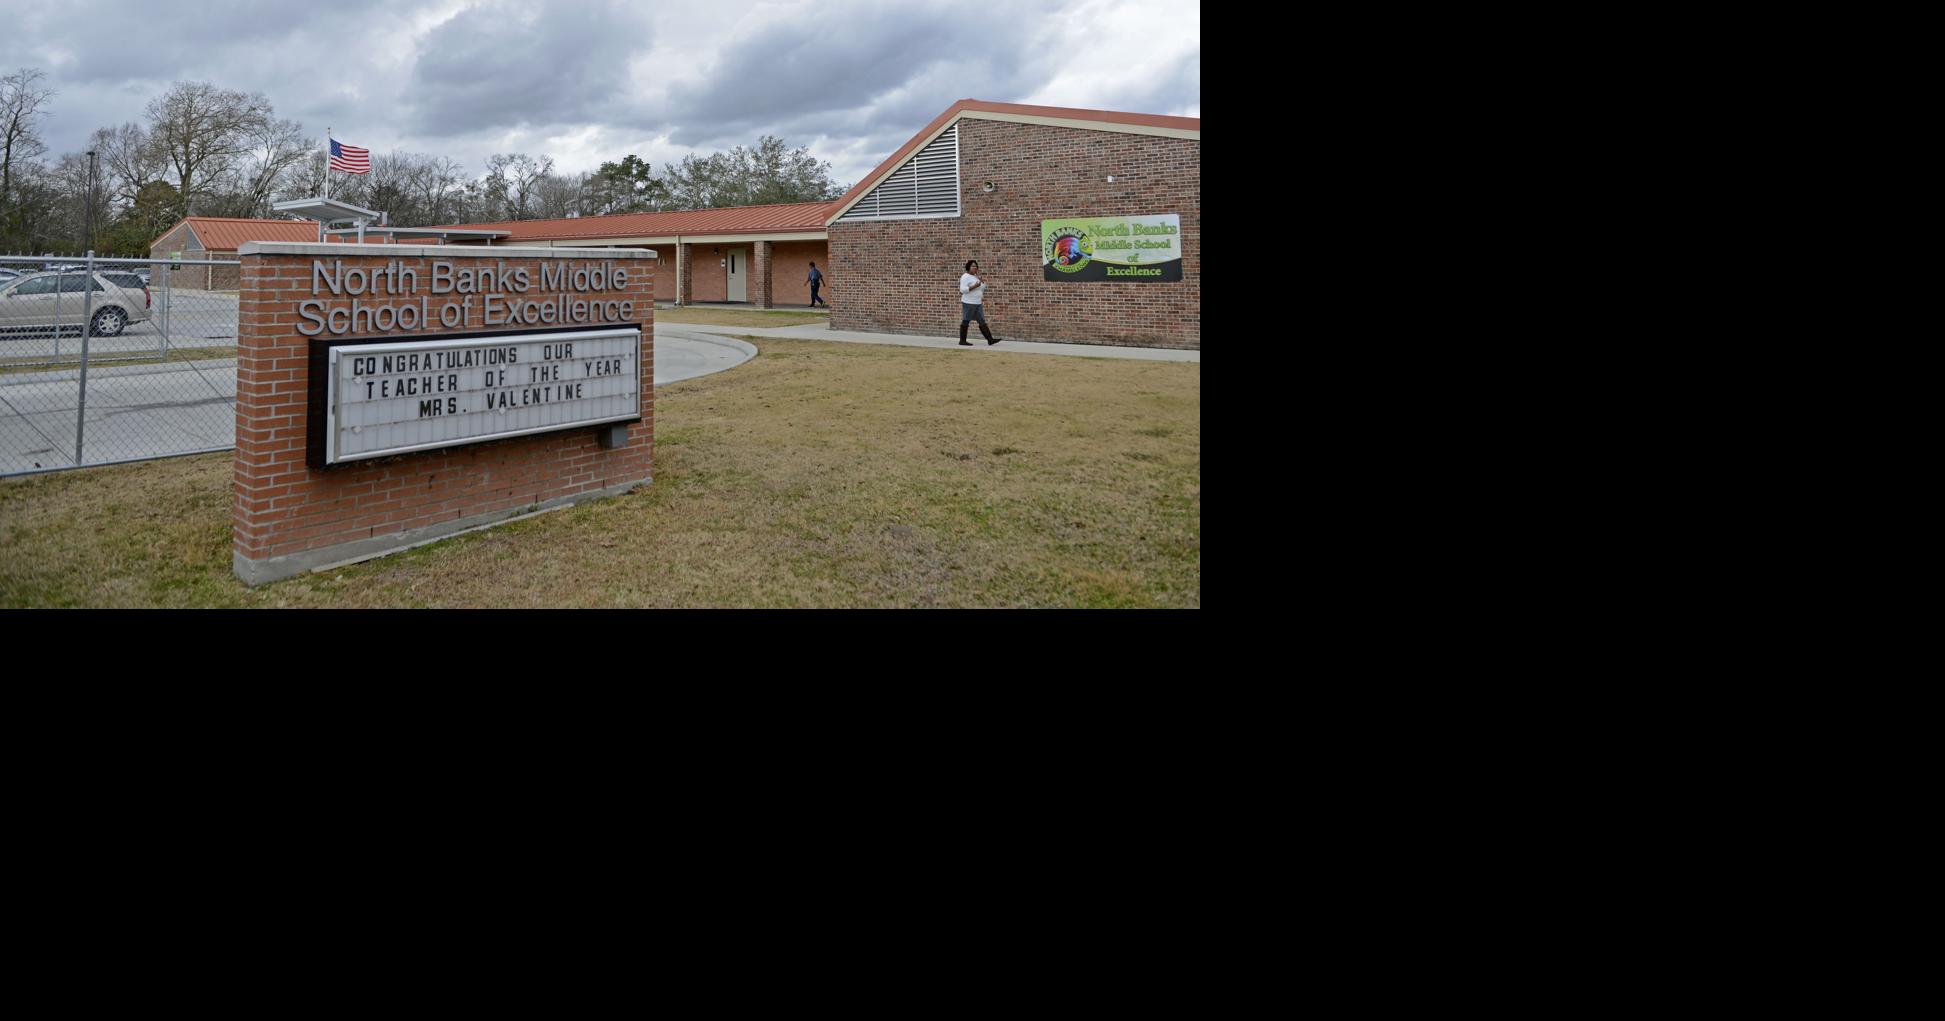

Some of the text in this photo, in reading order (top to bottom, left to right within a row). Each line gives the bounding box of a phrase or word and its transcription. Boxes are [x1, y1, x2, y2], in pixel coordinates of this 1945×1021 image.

[1087, 221, 1177, 237] North Banks
[1095, 238, 1171, 250] Middle School
[1106, 266, 1162, 276] Excellence
[1126, 253, 1140, 262] of
[312, 260, 628, 296] North Banks Middle
[296, 294, 634, 336] School of Excellence
[353, 343, 573, 376] CONGRATULATIONS OUR
[366, 359, 621, 399] TEACHER OF THE YEAR
[419, 383, 582, 418] MRS. VALENTINE
